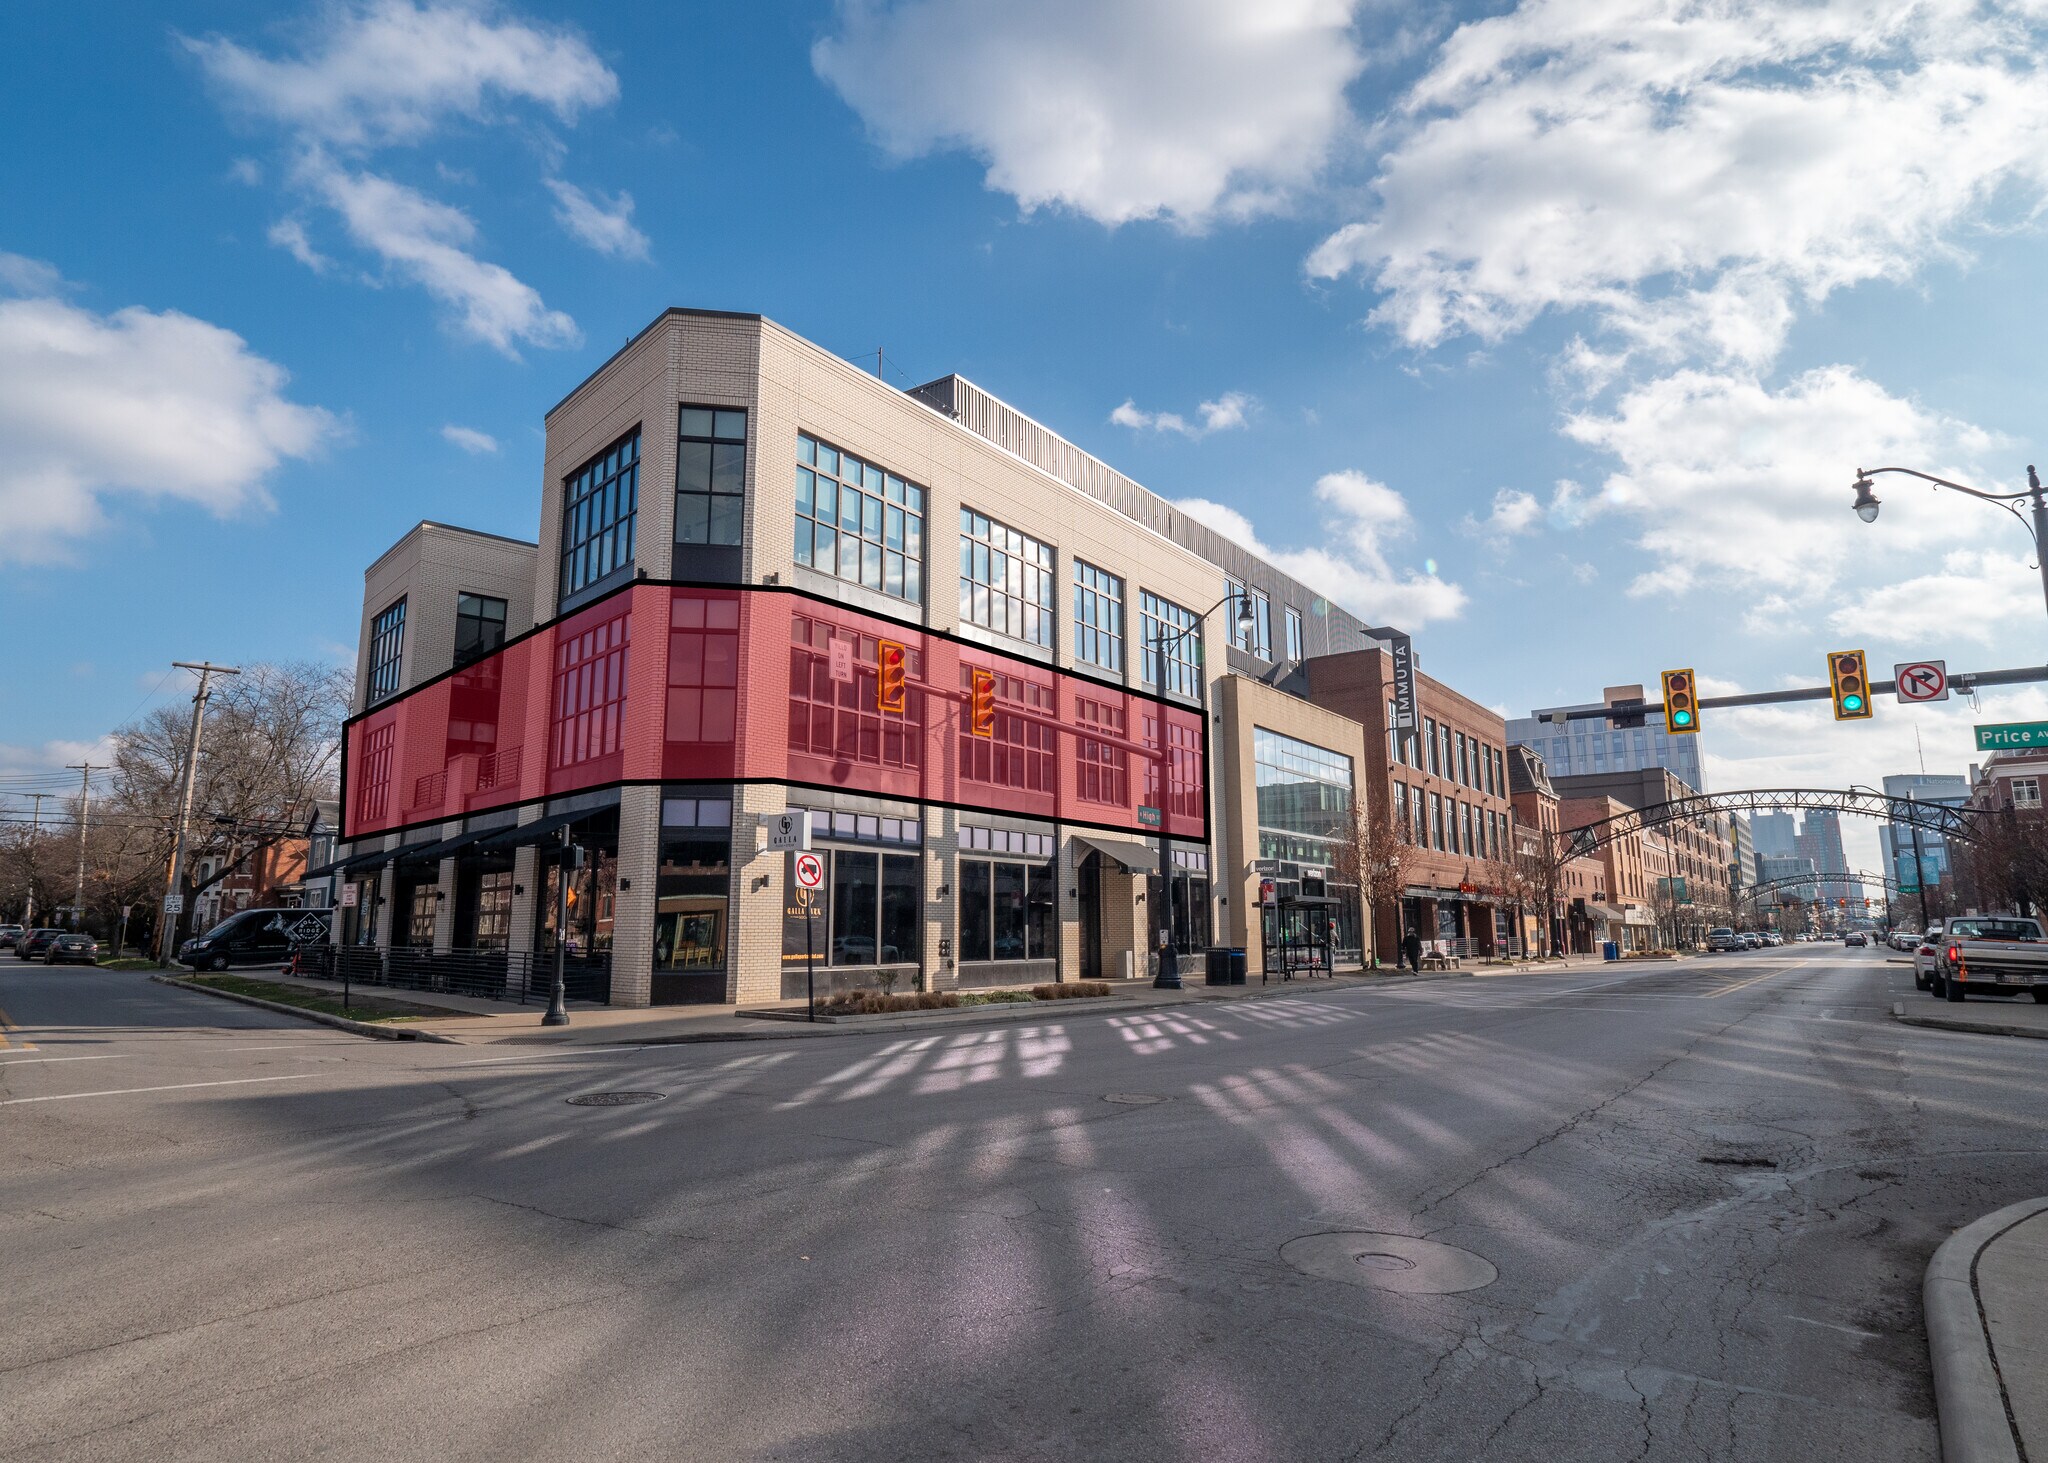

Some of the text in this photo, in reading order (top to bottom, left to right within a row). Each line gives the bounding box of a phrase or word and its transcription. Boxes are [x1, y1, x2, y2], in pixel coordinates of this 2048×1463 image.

[835, 670, 847, 678] TURN
[1396, 645, 1411, 721] IMMUTA
[1981, 730, 2031, 744] Price
[1926, 777, 1960, 785] Nationwide
[1142, 811, 1155, 823] High
[773, 835, 797, 845] GALLA
